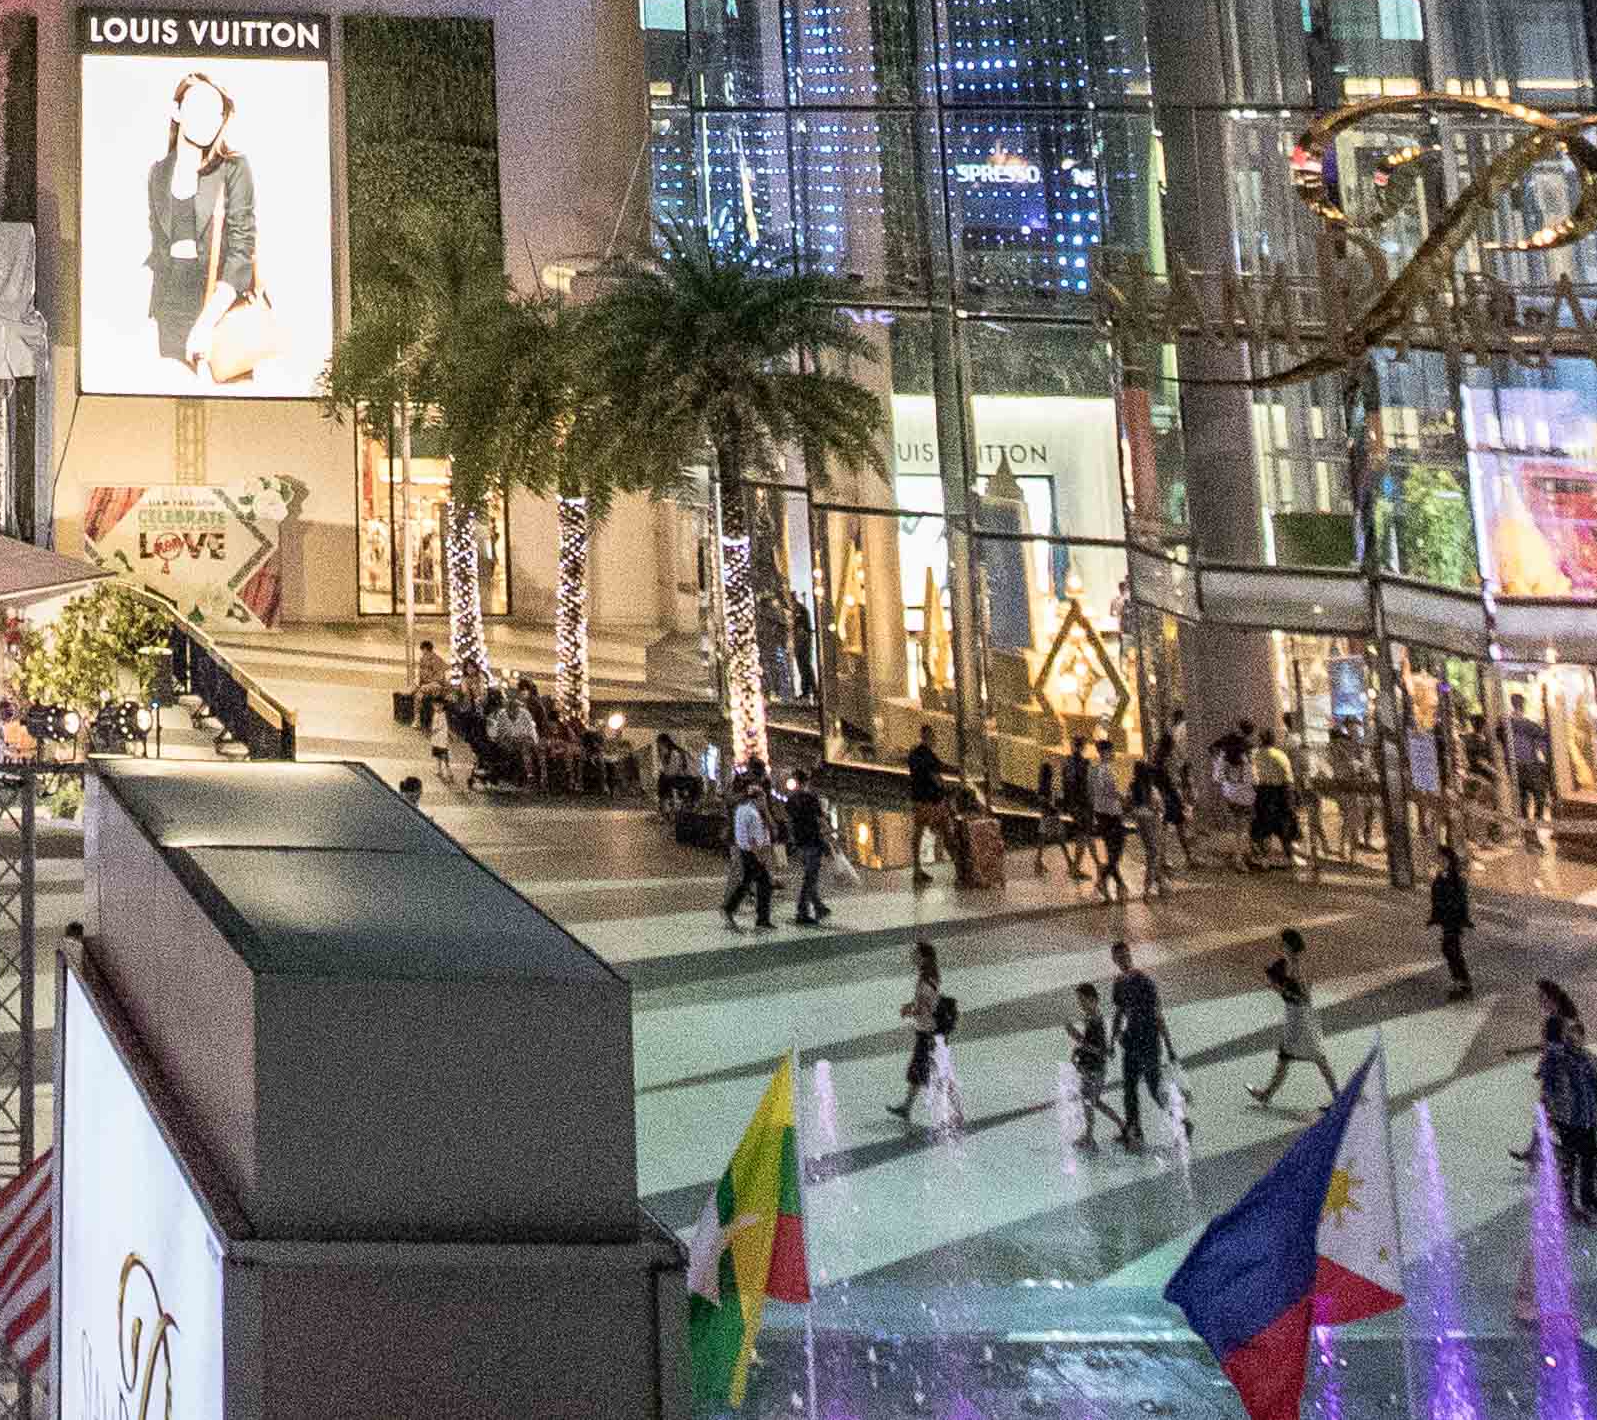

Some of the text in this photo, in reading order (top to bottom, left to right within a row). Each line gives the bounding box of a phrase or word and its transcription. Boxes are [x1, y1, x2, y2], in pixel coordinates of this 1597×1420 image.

[90, 16, 321, 49] LOUIS VUITTON
[955, 164, 1041, 185] SPRESSO
[897, 442, 1048, 464] UIS ITTON
